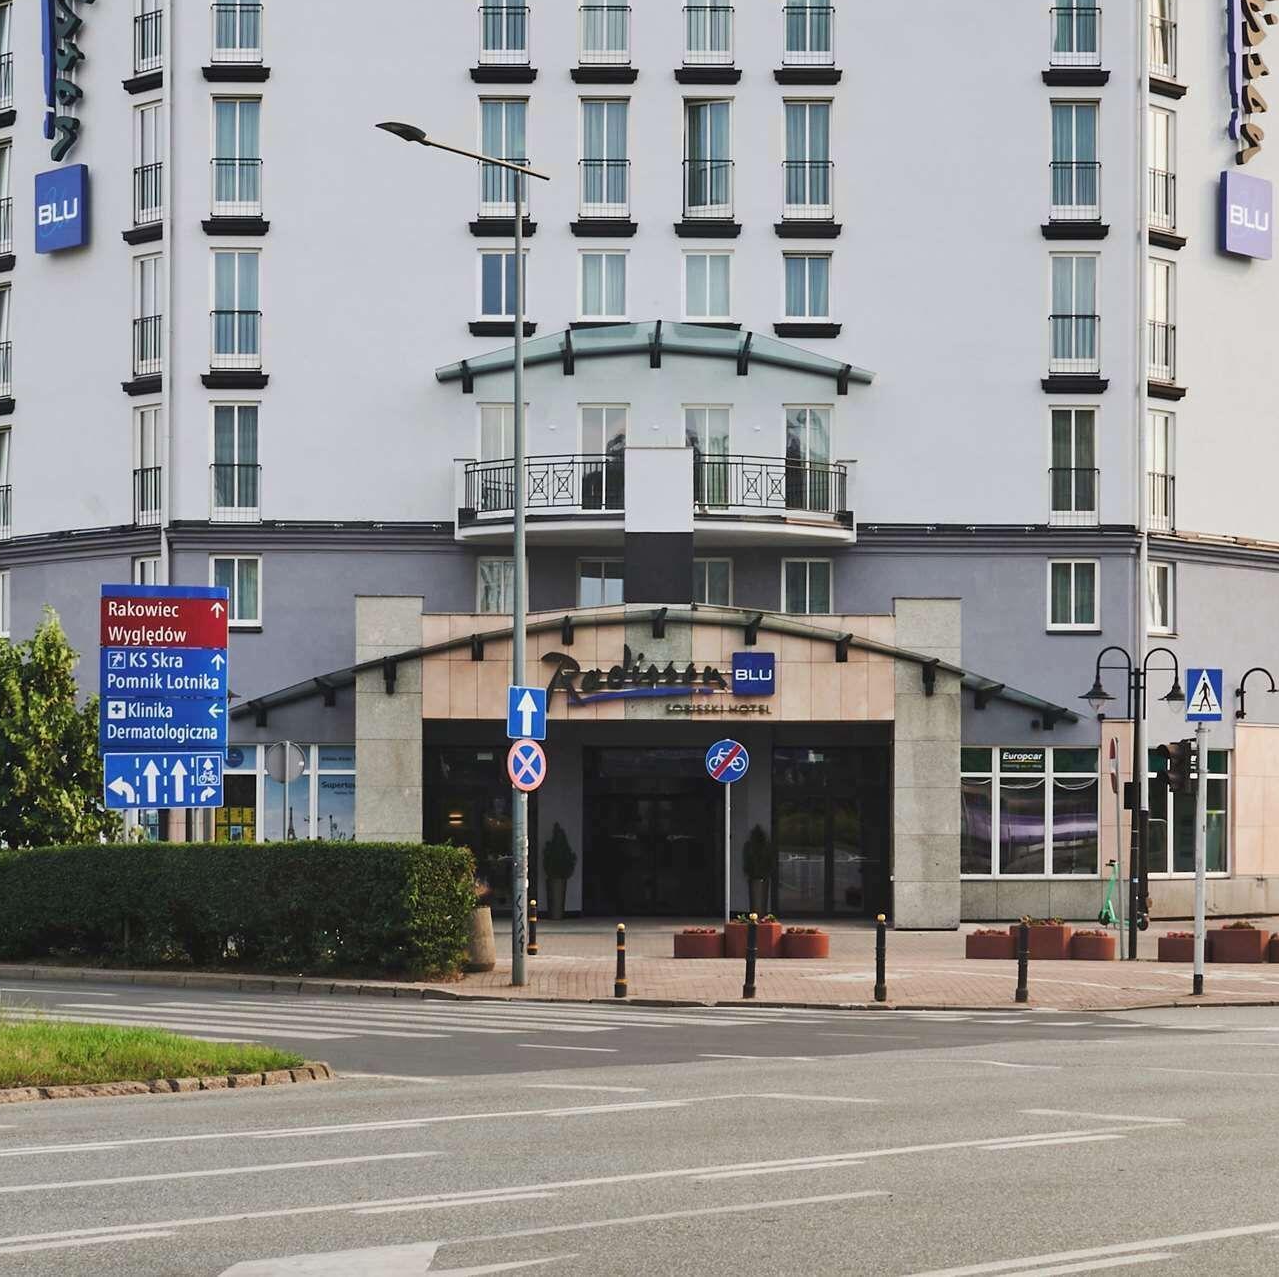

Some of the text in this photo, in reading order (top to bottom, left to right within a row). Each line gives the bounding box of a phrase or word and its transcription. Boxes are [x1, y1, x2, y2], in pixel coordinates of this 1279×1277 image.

[38, 196, 79, 226] BLU
[1229, 203, 1270, 231] BLU
[108, 601, 179, 618] Rakowiec
[108, 626, 187, 645] Wyględów
[129, 652, 183, 669] KS Skra
[107, 674, 220, 690] Pomnik Lotnika
[734, 668, 773, 681] BLU
[128, 702, 173, 719] Klinika
[107, 724, 218, 743] Dermatologiczna
[1002, 752, 1043, 762] Europcar
